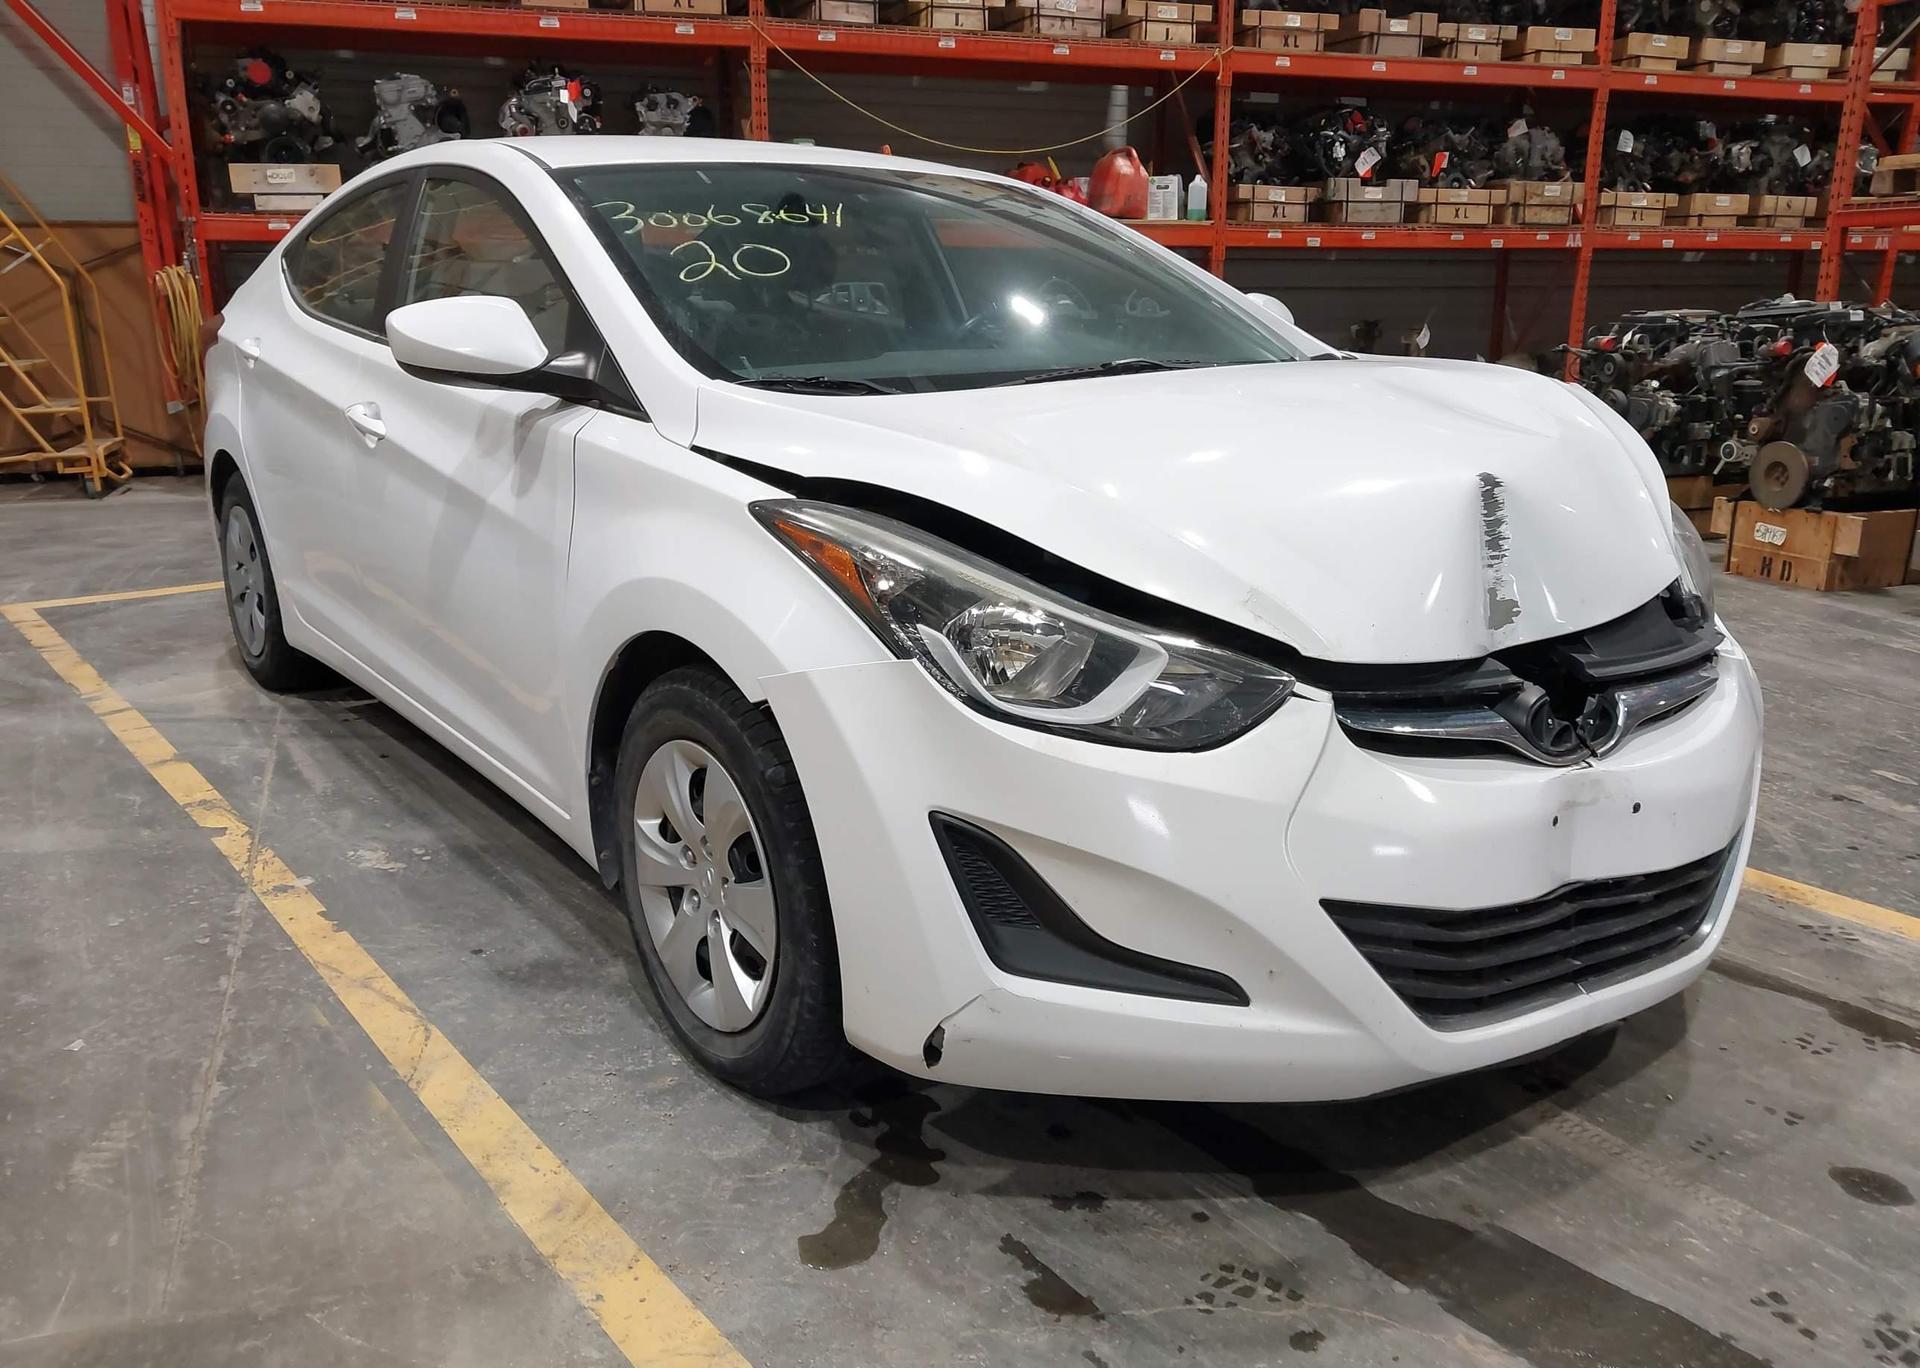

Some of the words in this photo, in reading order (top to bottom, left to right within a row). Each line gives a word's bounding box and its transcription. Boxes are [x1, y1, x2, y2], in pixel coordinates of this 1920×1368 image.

[1283, 34, 1300, 48] XL
[1272, 205, 1288, 219] XL
[1454, 207, 1470, 220] XL
[1631, 210, 1645, 222] XL
[1566, 233, 1583, 248] AA
[670, 240, 791, 282] 20
